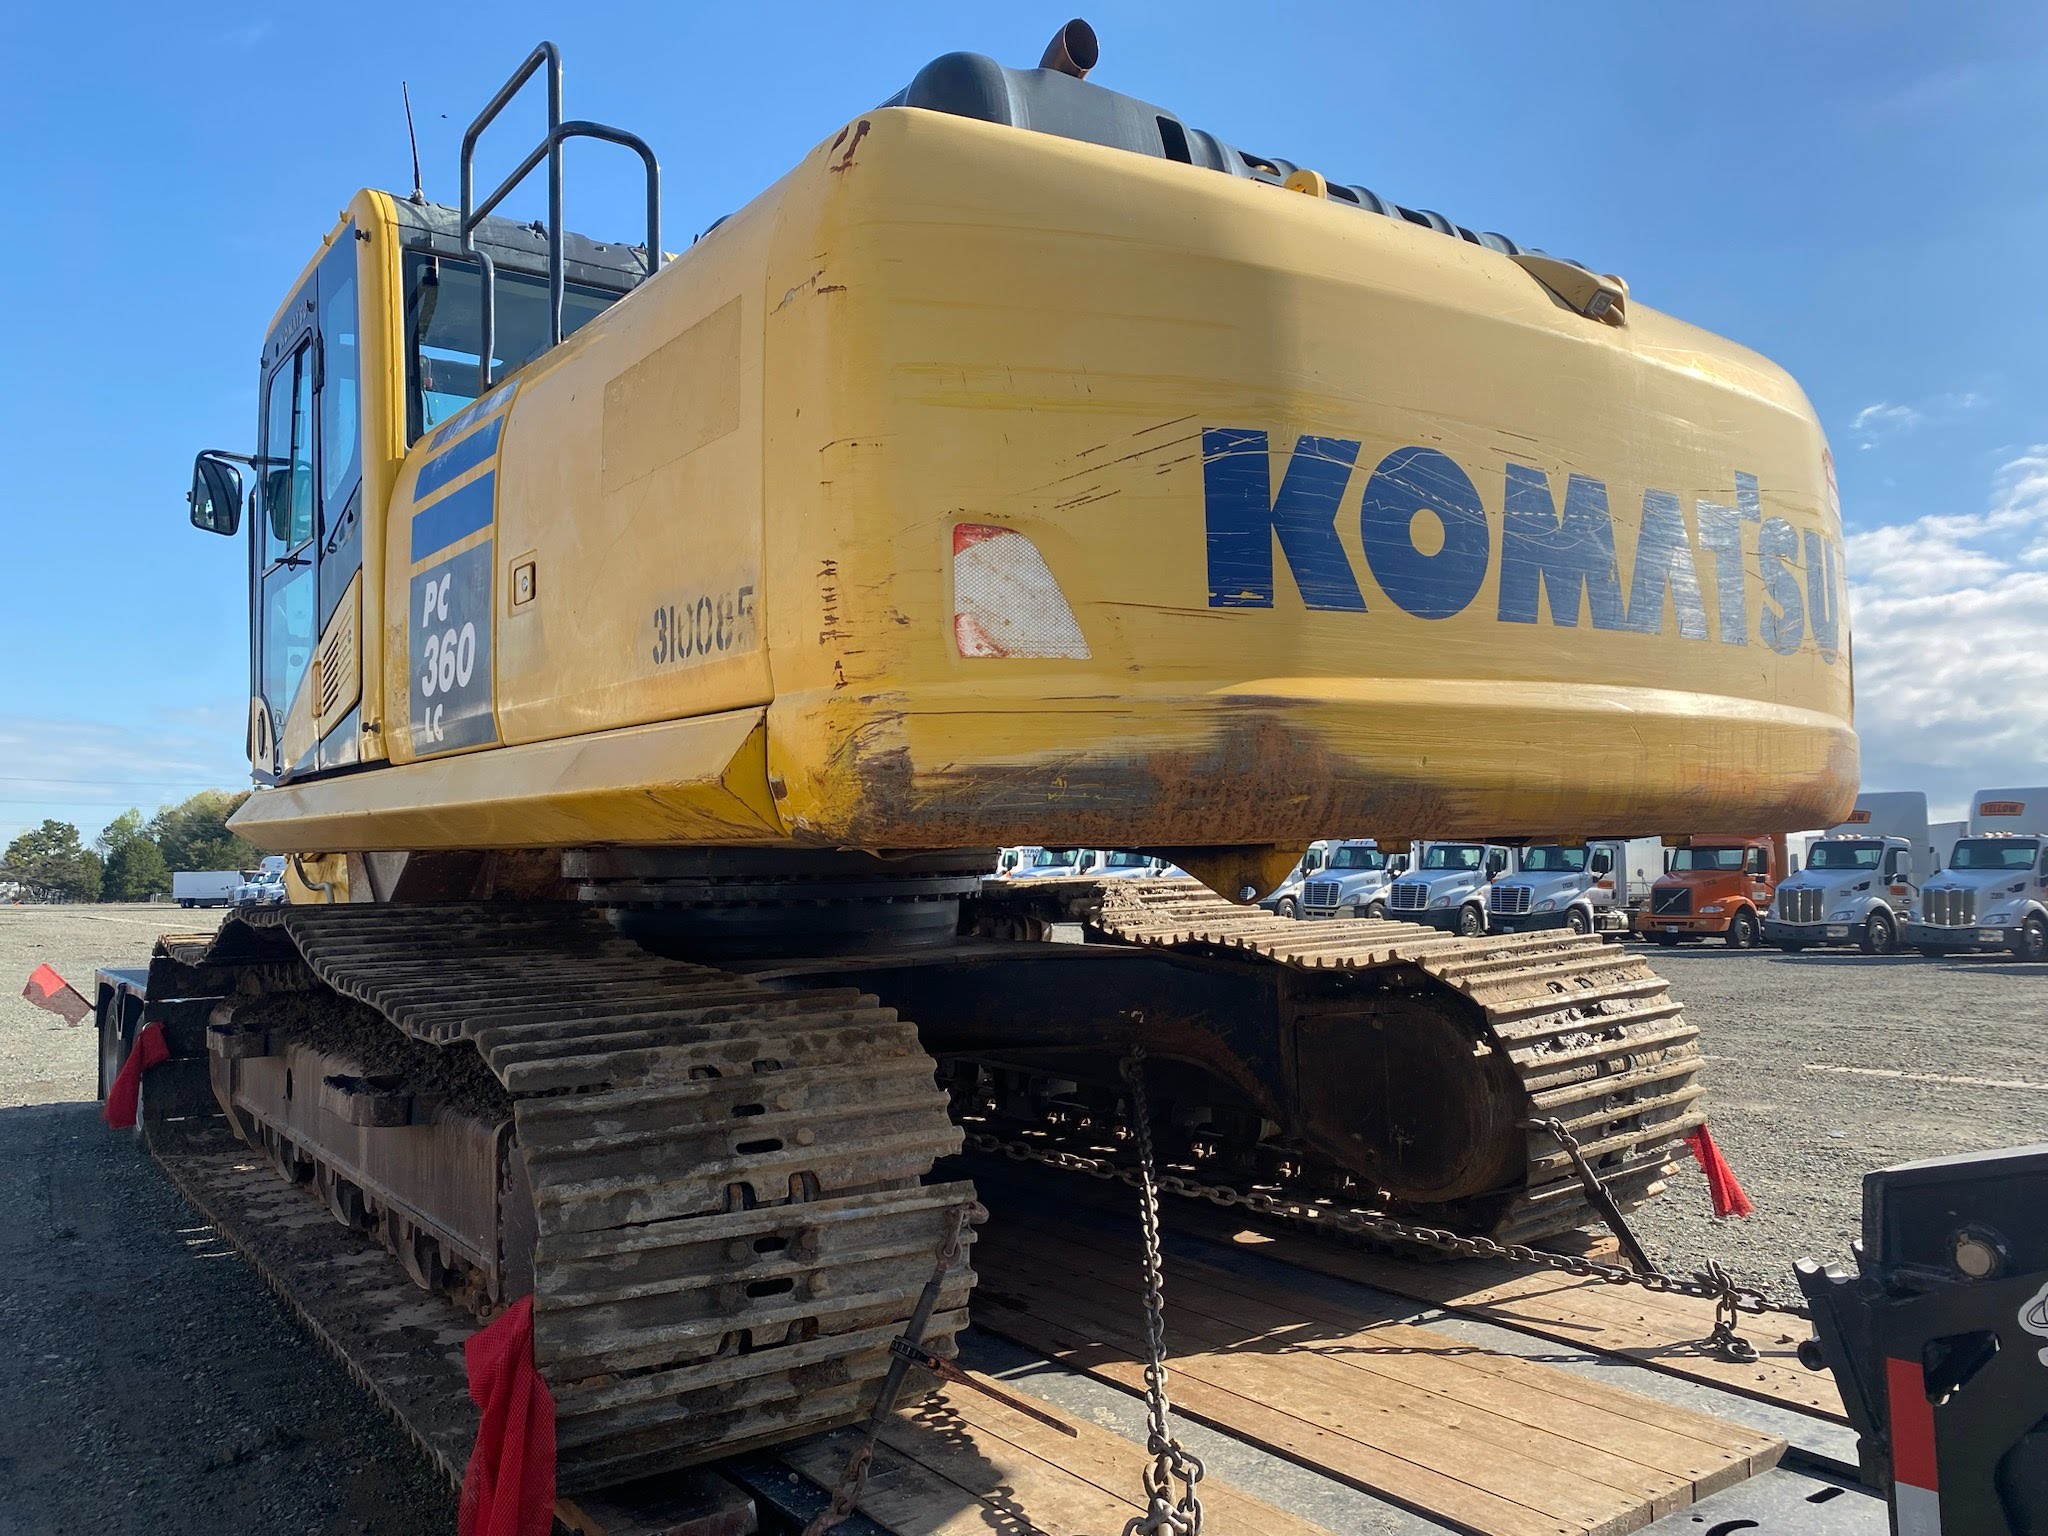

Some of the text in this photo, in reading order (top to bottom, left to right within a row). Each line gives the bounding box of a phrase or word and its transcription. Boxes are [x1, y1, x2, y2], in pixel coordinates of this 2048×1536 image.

[1202, 426, 1838, 665] KOMATSU
[422, 573, 451, 628] PC
[421, 621, 475, 697] 360
[424, 703, 444, 743] LC
